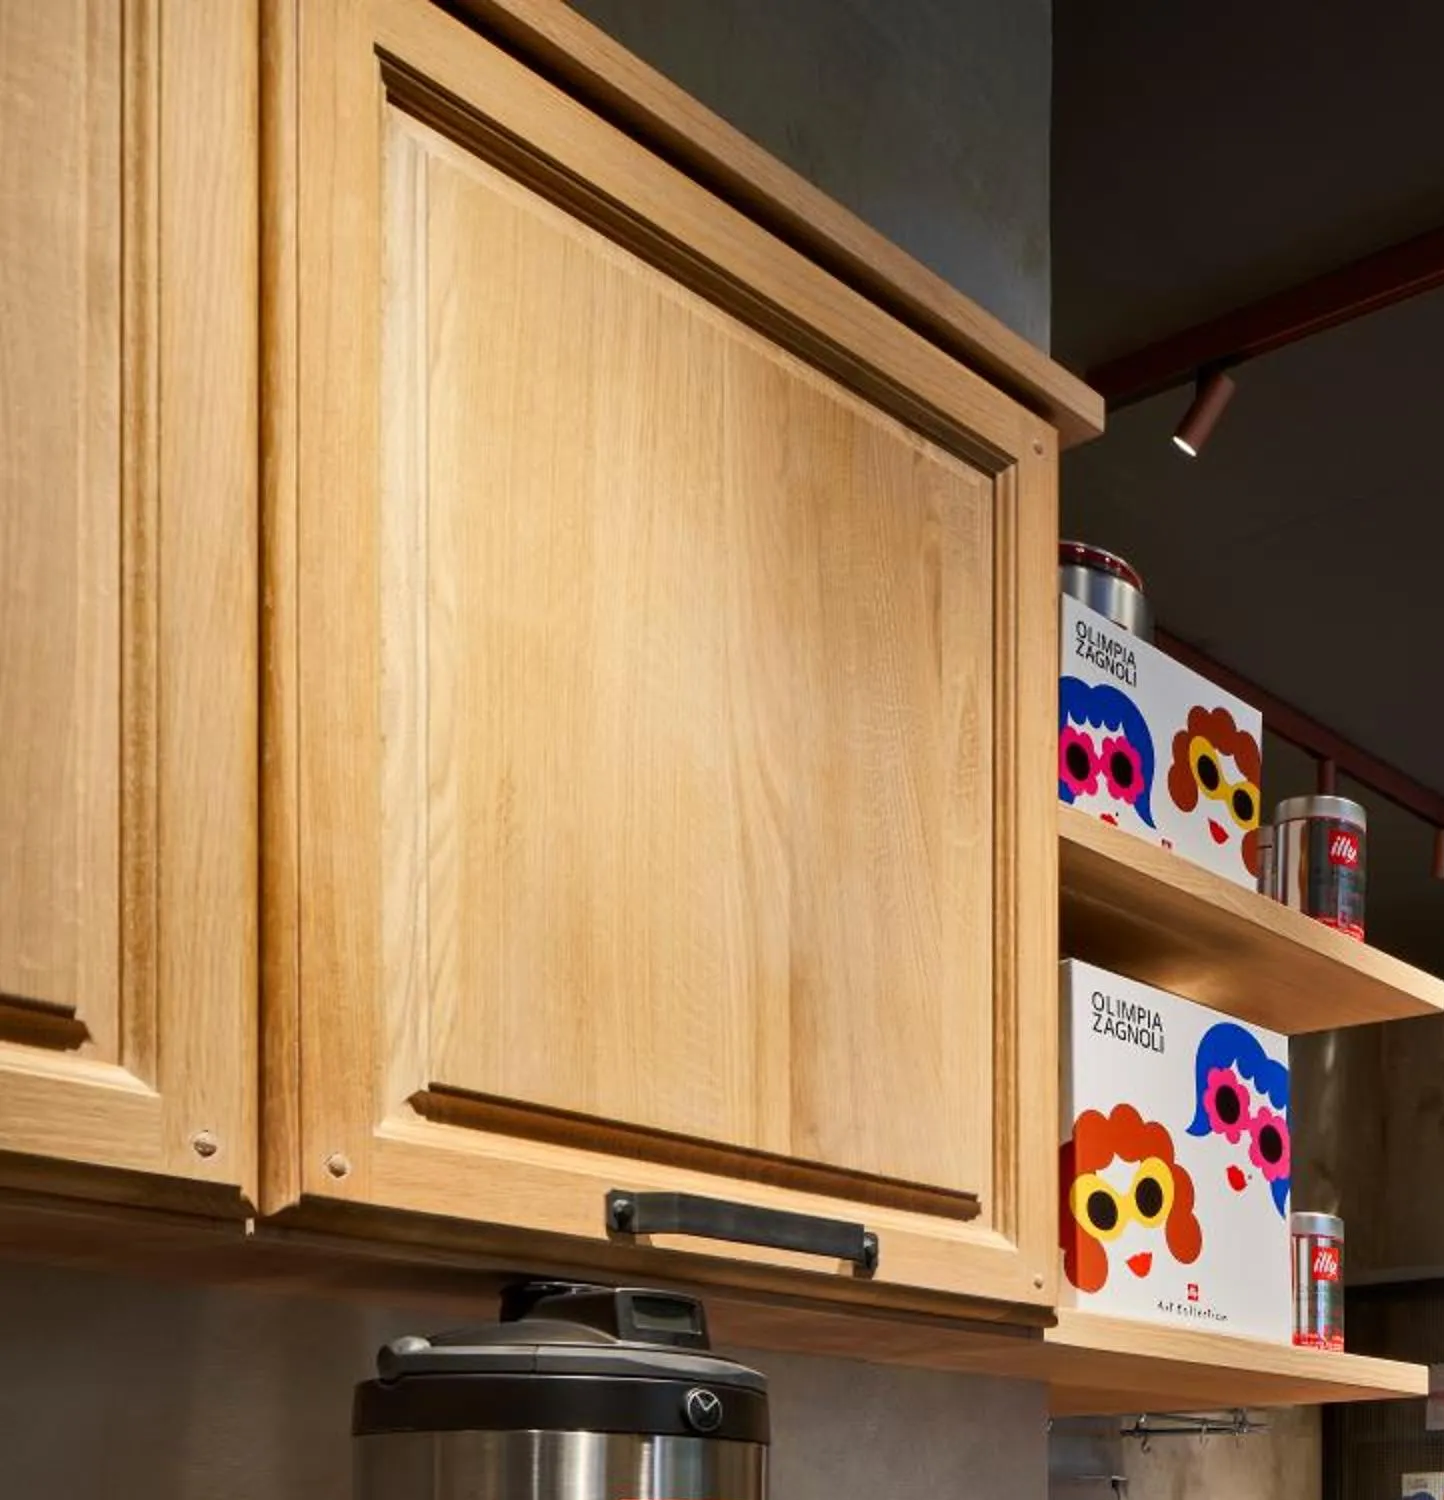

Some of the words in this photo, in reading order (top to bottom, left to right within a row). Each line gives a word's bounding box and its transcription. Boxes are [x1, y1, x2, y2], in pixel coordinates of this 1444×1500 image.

[1075, 620, 1137, 669] OLIMPIA
[1075, 637, 1137, 688] ZAGNOLI
[1331, 835, 1357, 864] illy
[1091, 991, 1163, 1033] OLIMPIA
[1092, 1011, 1165, 1054] ZAGNOLI
[1313, 1251, 1338, 1279] illy
